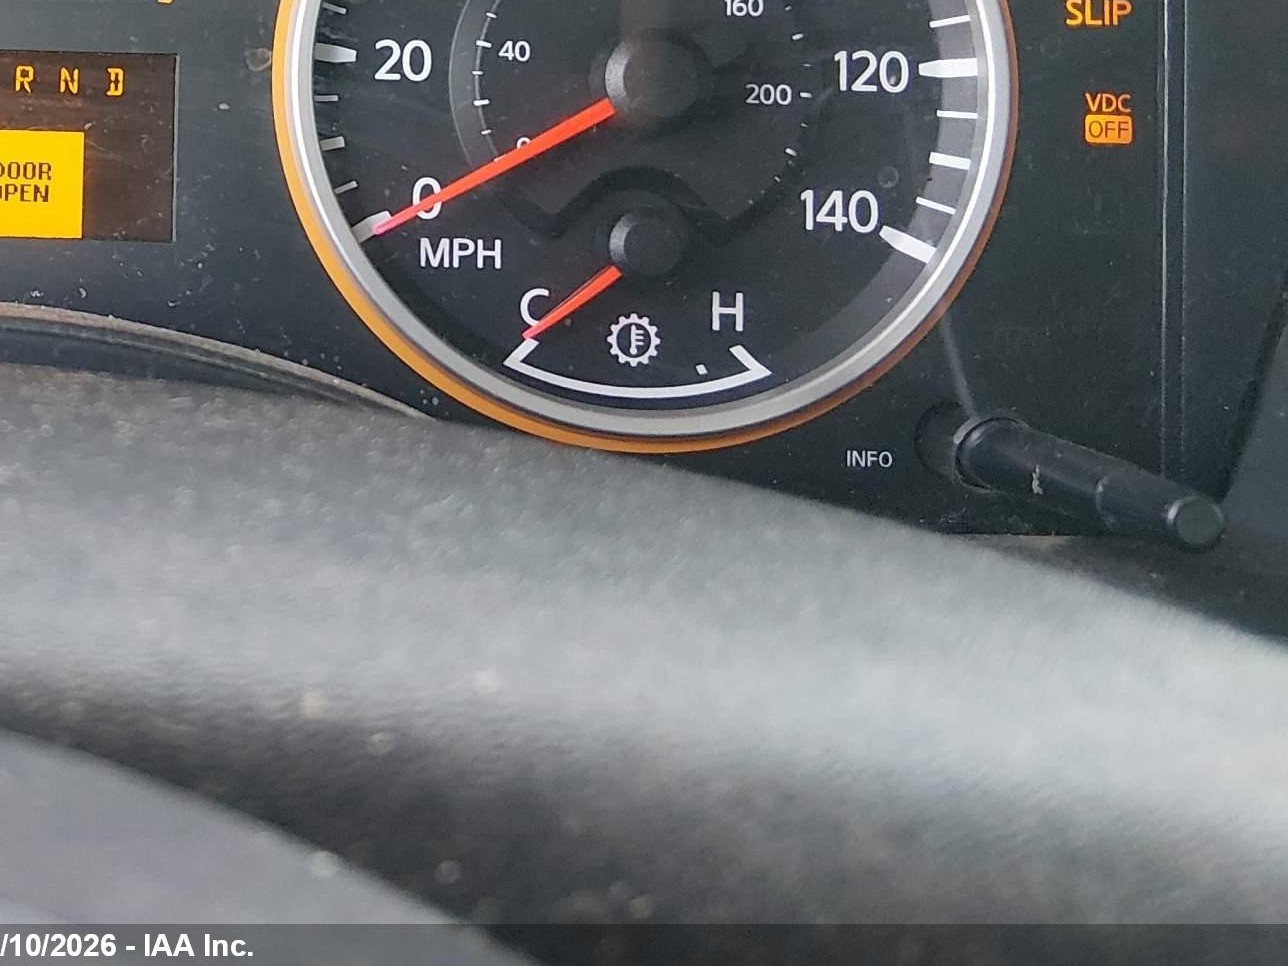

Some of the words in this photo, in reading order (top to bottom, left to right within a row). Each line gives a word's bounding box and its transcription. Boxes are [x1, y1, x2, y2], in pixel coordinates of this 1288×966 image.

[374, 39, 432, 82] 20
[498, 40, 531, 63] 40
[15, 65, 35, 94] R
[59, 67, 79, 95] N
[106, 67, 125, 97] D
[834, 50, 910, 93] 120
[745, 84, 792, 105] 200
[1085, 92, 1132, 113] VDC
[1088, 120, 1129, 139] OFF
[412, 177, 443, 220] 0
[800, 189, 879, 233] 140
[420, 237, 502, 269] MPH
[520, 288, 550, 328] C
[712, 291, 744, 332] H
[846, 450, 893, 468] INFO
